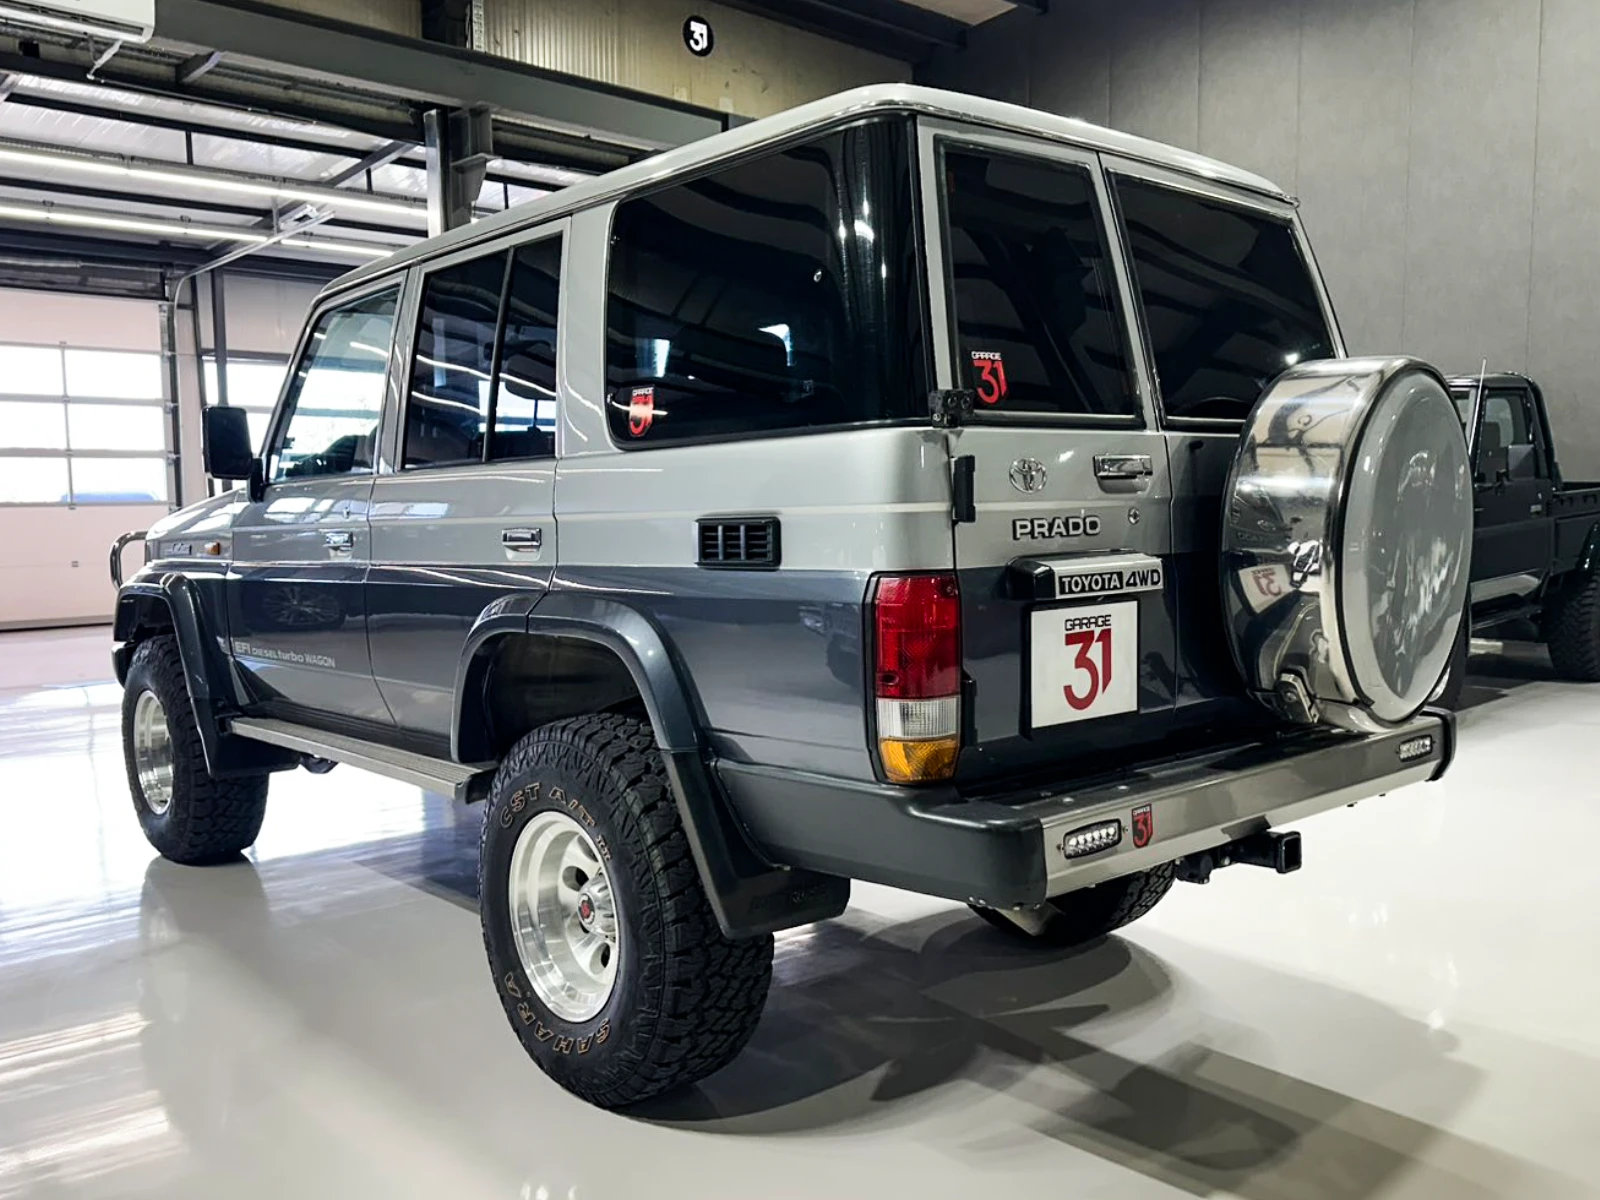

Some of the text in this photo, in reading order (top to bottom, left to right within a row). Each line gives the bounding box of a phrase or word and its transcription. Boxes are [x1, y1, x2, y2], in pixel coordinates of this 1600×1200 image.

[690, 20, 708, 51] 31
[973, 359, 1007, 403] 31
[1012, 514, 1101, 540] PRADO
[1061, 569, 1161, 594] TOYOTA 4WD
[1064, 614, 1112, 632] GARAGE
[278, 650, 304, 663] turbo
[304, 653, 336, 669] WAGON
[1063, 627, 1112, 711] 31
[500, 782, 540, 829] CST
[504, 971, 611, 1055] SAHARA
